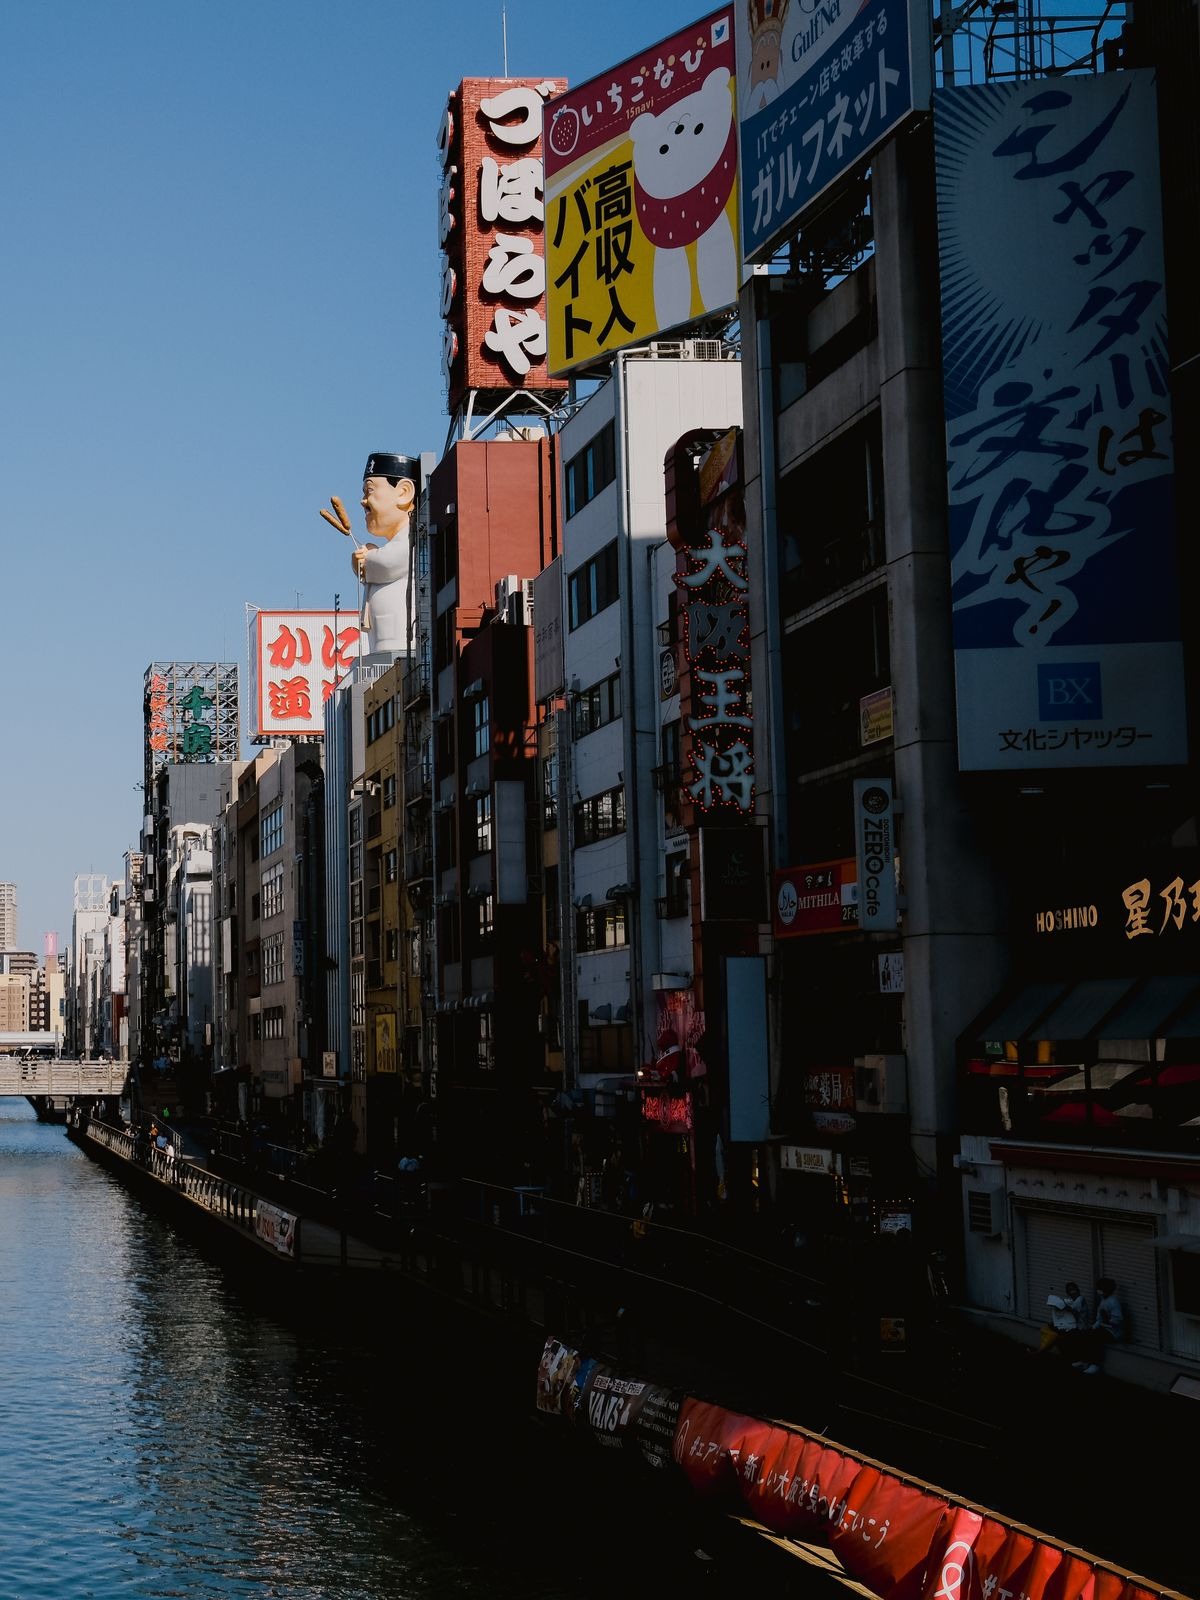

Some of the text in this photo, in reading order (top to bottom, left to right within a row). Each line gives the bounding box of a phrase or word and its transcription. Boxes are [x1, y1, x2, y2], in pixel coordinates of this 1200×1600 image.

[581, 37, 707, 126] いちごなび
[625, 97, 654, 120] 15navi
[757, 8, 888, 160] ITでチェーン店を改革する
[752, 48, 901, 235] ガルフネット
[553, 179, 594, 361] バイト
[593, 160, 636, 346] 高収入
[267, 624, 360, 669] かに
[673, 529, 754, 811] 大阪王将
[1048, 678, 1093, 705] BX
[798, 891, 841, 910] MITHILA
[864, 818, 885, 917] ZERO cafe
[1036, 904, 1098, 933] HOSHINO
[819, 1072, 842, 1107] 薬局
[589, 1390, 625, 1432] VANS
